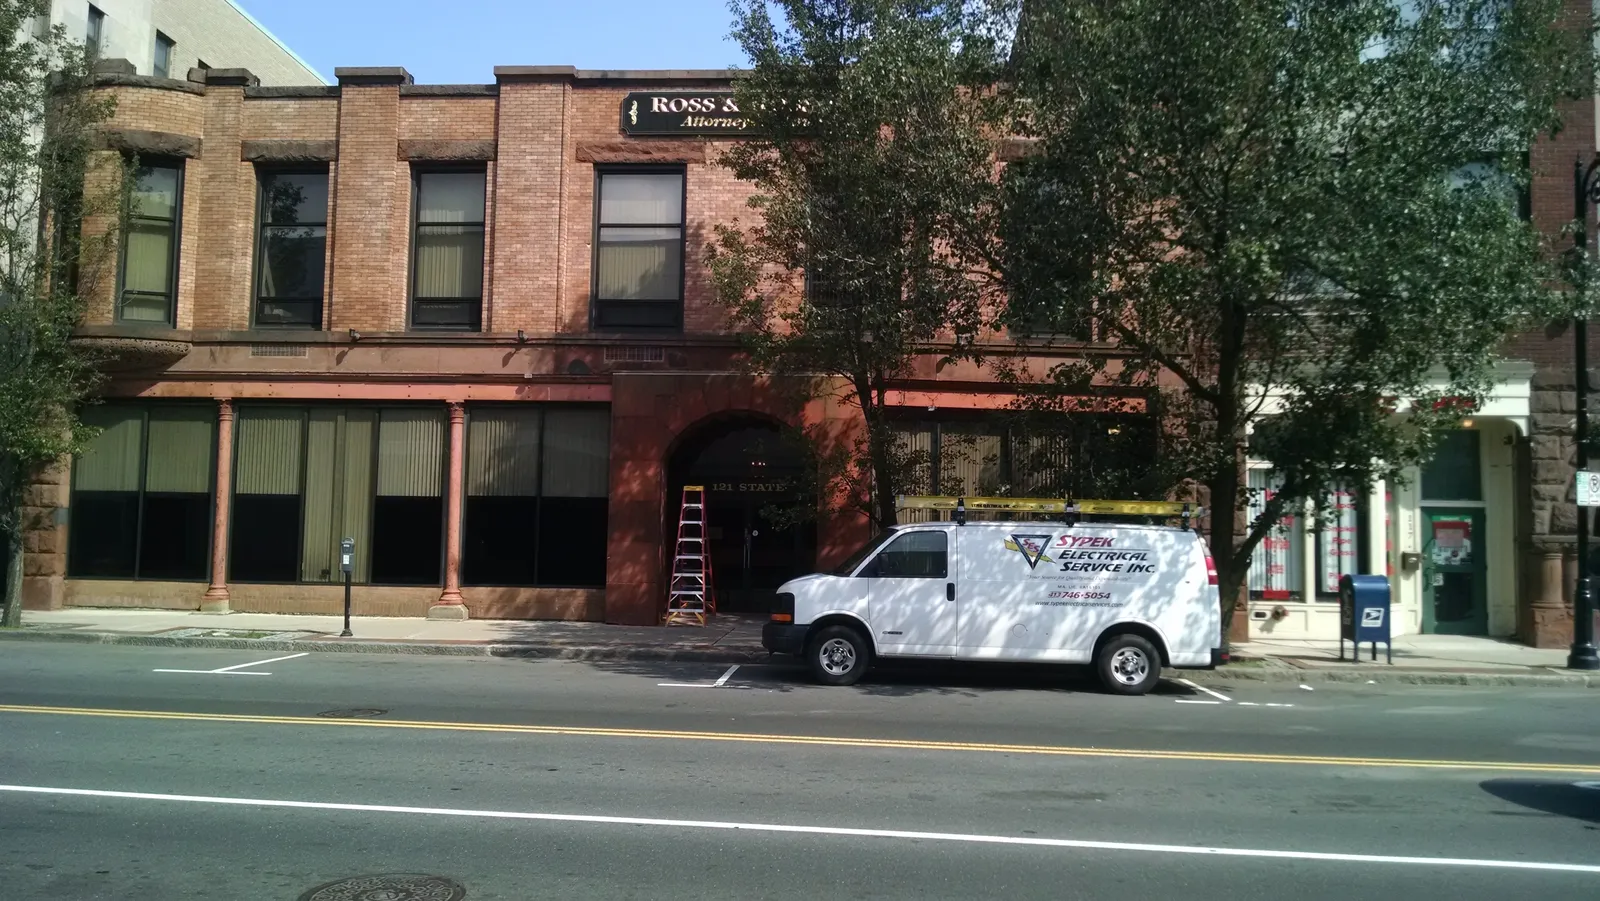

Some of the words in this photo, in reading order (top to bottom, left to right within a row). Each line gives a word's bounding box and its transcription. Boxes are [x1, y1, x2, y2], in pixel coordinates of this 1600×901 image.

[650, 96, 715, 113] ROSS
[712, 483, 733, 491] 121
[739, 483, 785, 492] STATE
[1022, 538, 1040, 553] SES
[1056, 535, 1116, 548] SYPEK
[1058, 550, 1148, 561] ELECTRICAL
[1060, 561, 1123, 573] SERVICE
[1126, 563, 1155, 573] INC.
